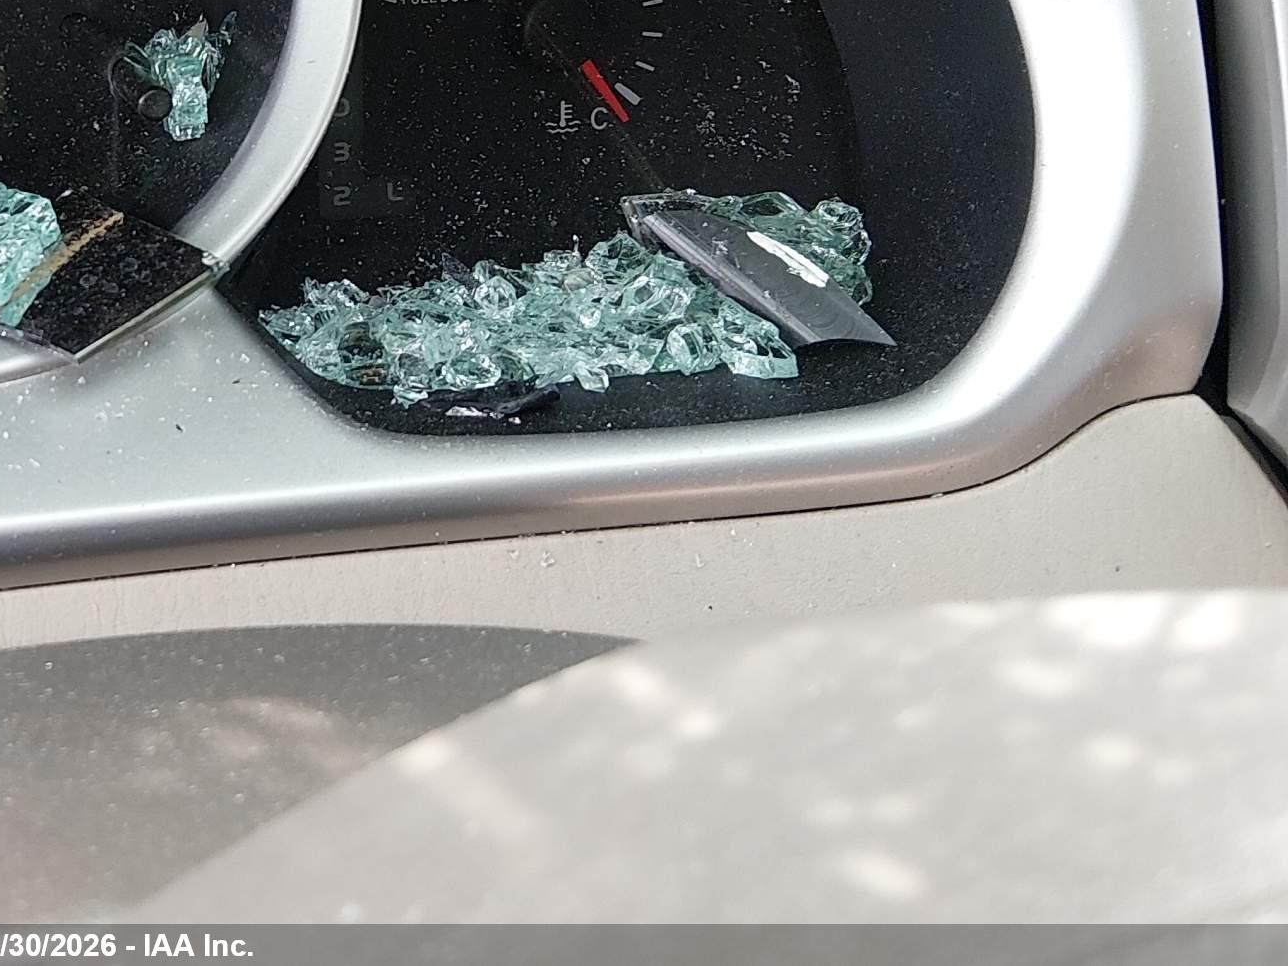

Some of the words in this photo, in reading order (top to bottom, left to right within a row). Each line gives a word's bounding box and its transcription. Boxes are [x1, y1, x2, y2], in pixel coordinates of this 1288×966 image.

[591, 108, 610, 131] C
[333, 141, 351, 162] 3
[333, 186, 351, 206] 2
